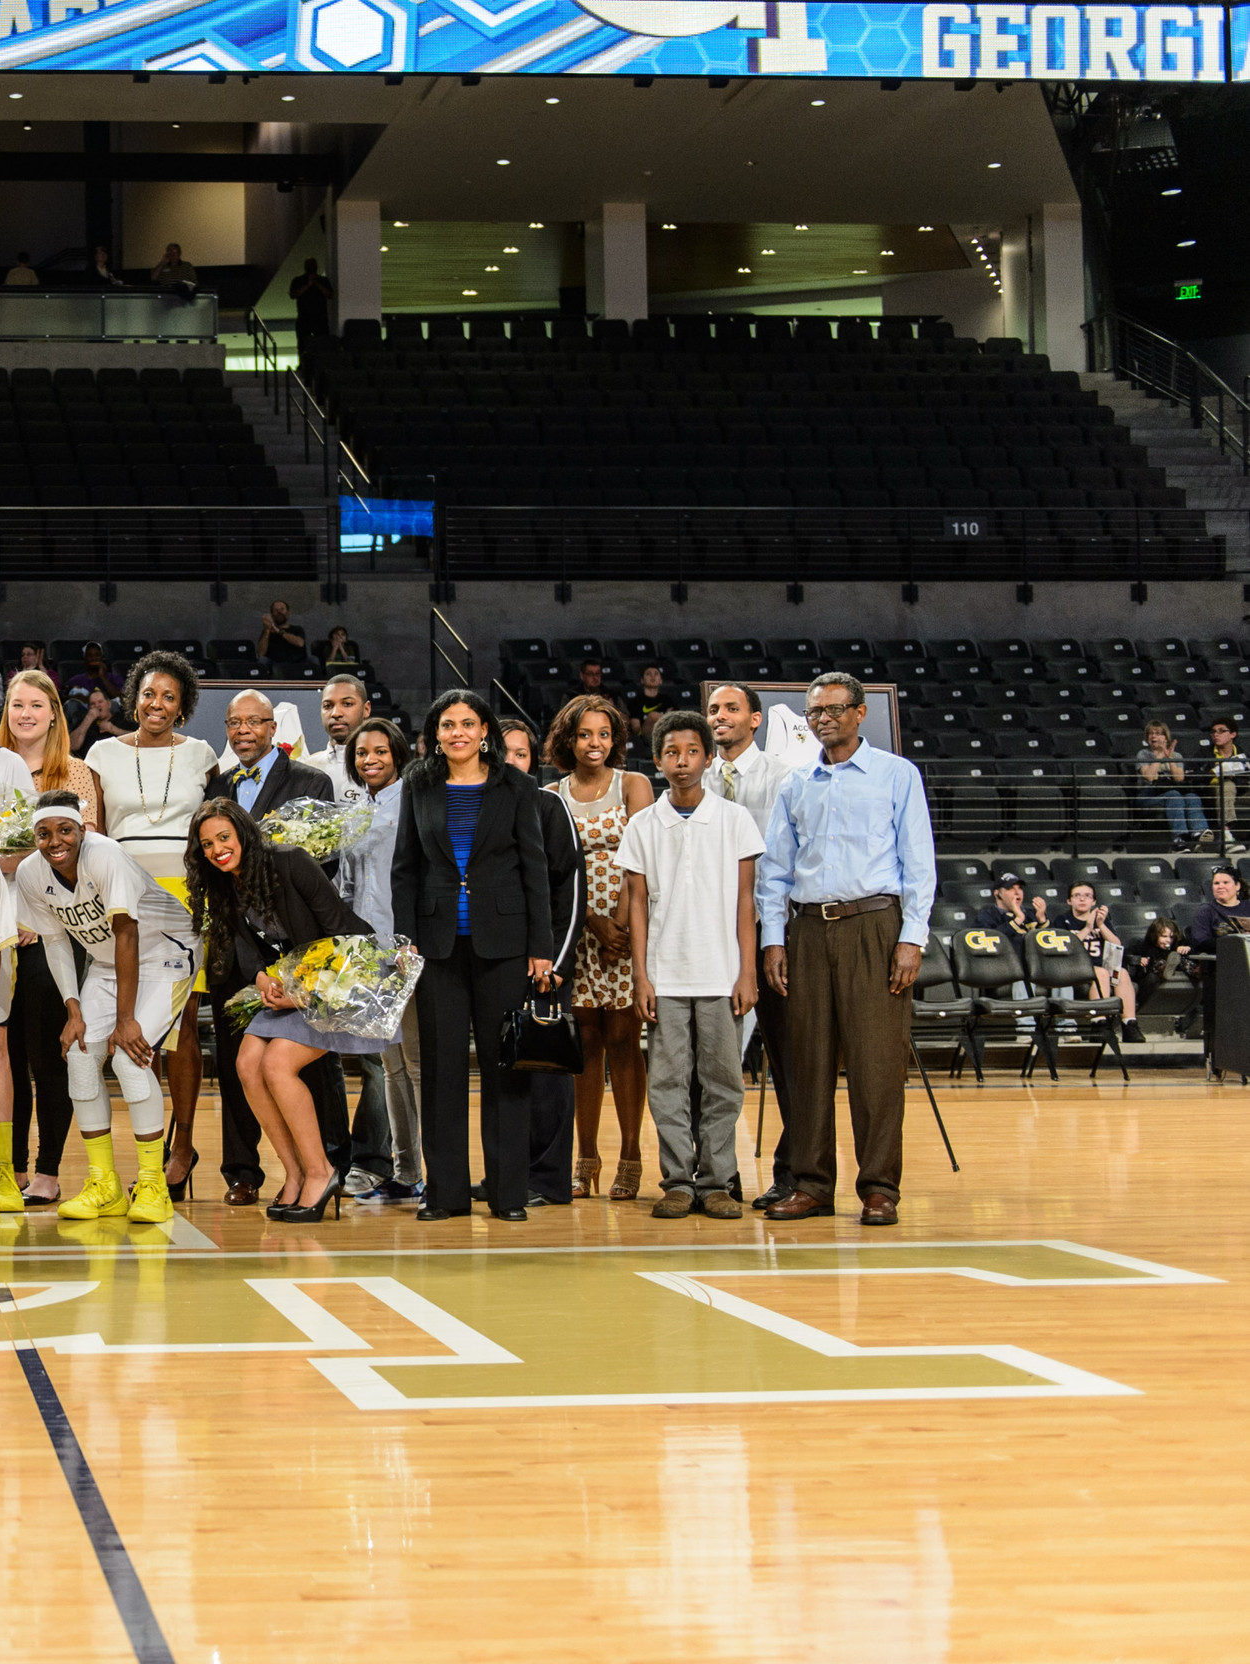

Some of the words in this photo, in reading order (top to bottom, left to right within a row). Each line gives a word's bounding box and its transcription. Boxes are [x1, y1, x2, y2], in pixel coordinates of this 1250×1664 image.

[922, 4, 1250, 80] GEORGI
[1180, 285, 1197, 298] EXIT
[952, 522, 979, 536] 110
[344, 789, 360, 800] GT
[965, 931, 1000, 952] GT
[1036, 930, 1071, 952] GT
